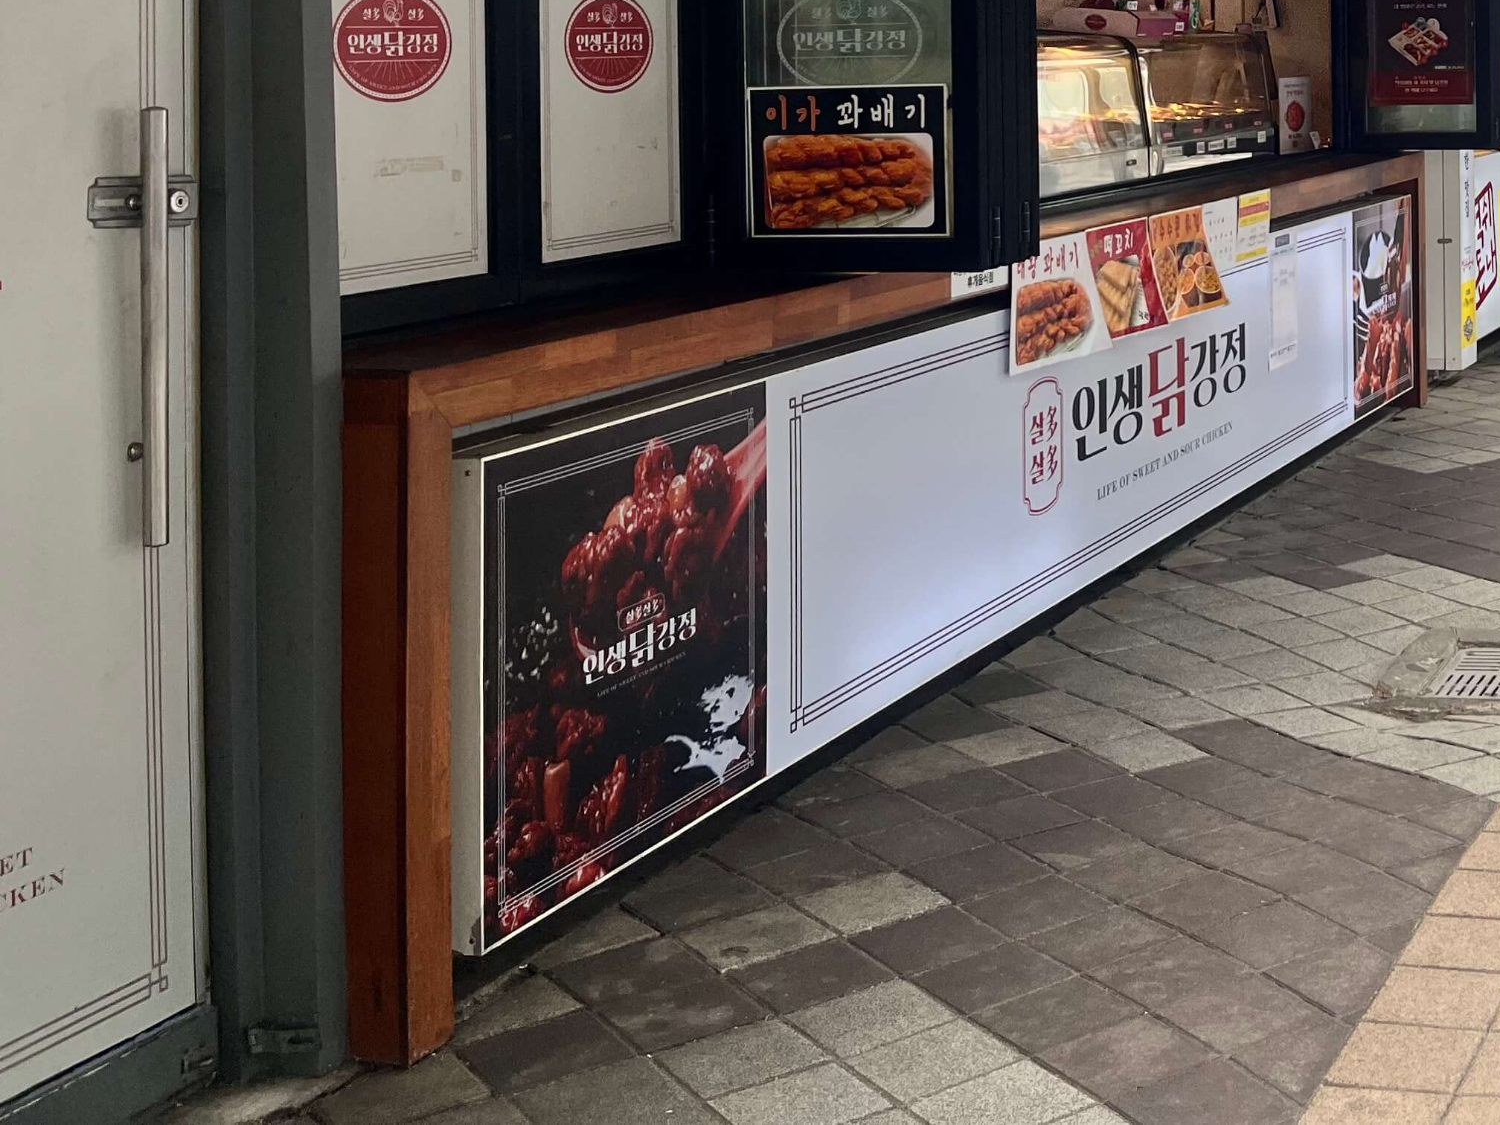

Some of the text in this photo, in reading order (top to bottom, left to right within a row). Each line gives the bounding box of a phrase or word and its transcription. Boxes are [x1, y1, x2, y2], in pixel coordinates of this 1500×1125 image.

[347, 31, 438, 56] 인생닭강정
[576, 31, 643, 53] 인생닭강정
[793, 28, 906, 53] 인생닭강정
[836, 93, 925, 130] 꽈배기
[1043, 241, 1079, 275] 꽈배기
[1103, 228, 1134, 258] 떡꼬치
[1071, 322, 1247, 462] 인생닭강정
[1096, 420, 1233, 501] LIFE OF SWEET AND SOUR CHICKEN
[583, 607, 697, 685] 인생닭강정
